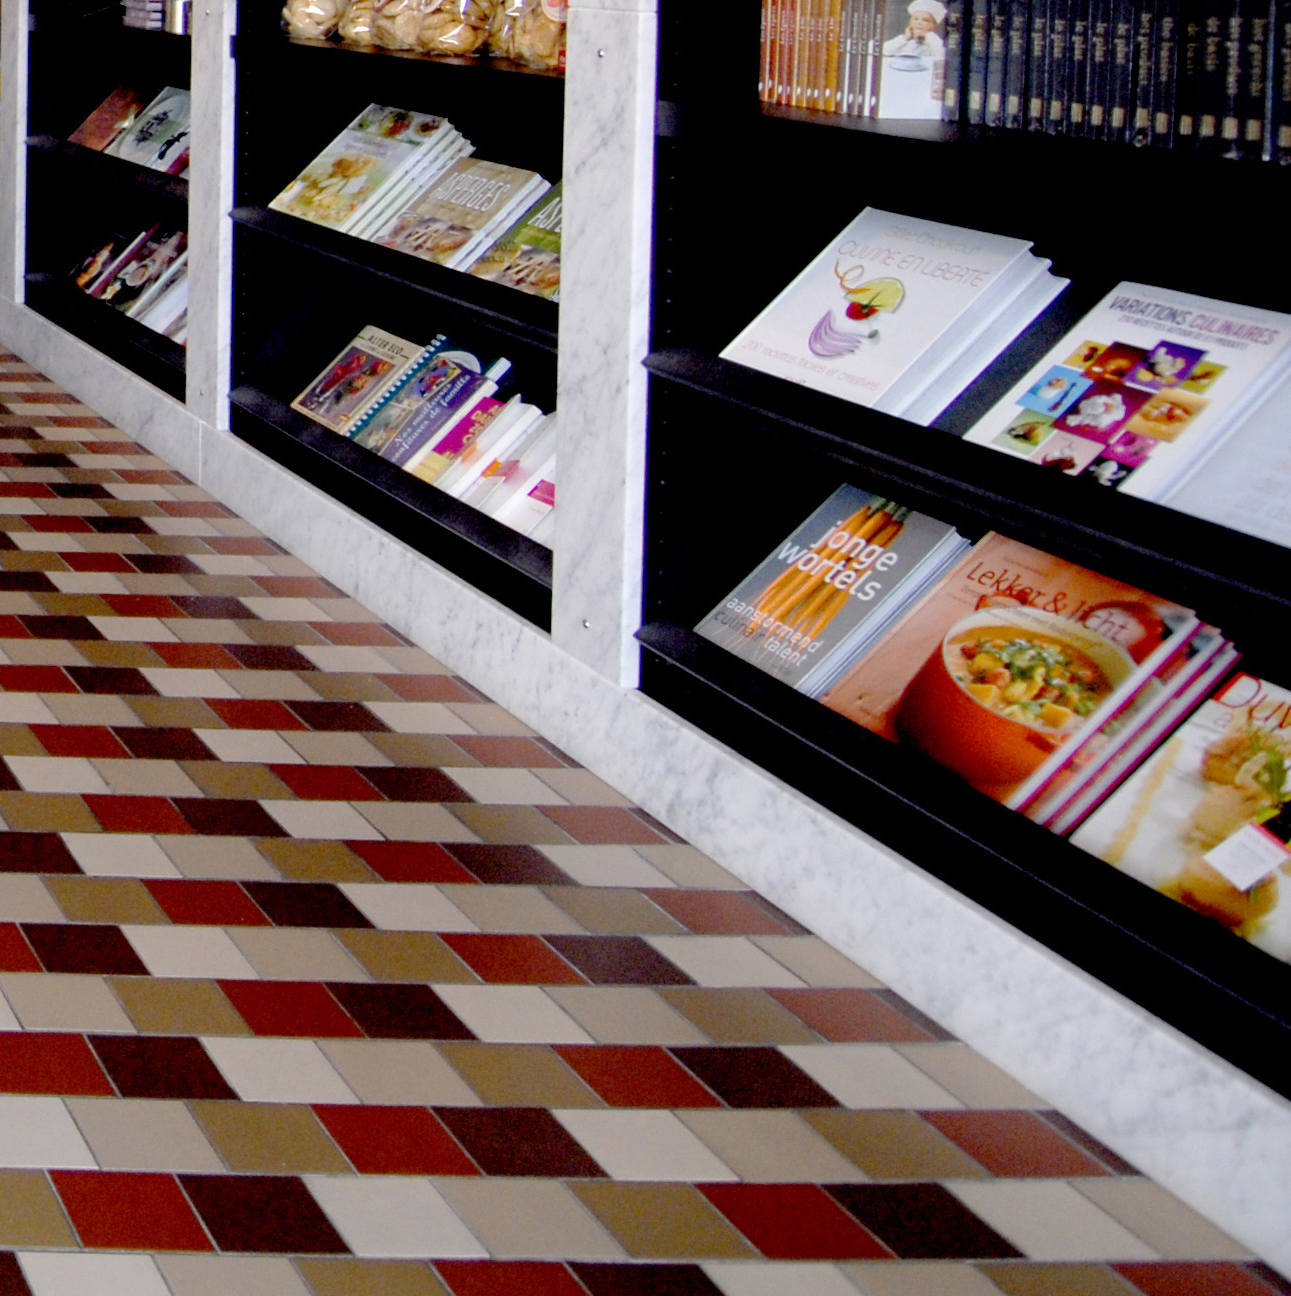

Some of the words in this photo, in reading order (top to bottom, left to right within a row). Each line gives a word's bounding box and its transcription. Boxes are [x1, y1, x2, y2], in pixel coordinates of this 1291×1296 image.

[430, 170, 511, 212] ASPERGES
[1108, 296, 1193, 326] VARIATIONS
[1189, 314, 1280, 345] CULINAIRES
[778, 542, 882, 601] wortels
[810, 520, 899, 572] jonge
[726, 597, 823, 653] aanstormend
[967, 562, 1046, 607] Lekker
[1043, 592, 1067, 614] &
[1070, 600, 1127, 641] licht
[714, 609, 766, 641] culinair
[764, 636, 807, 667] talent
